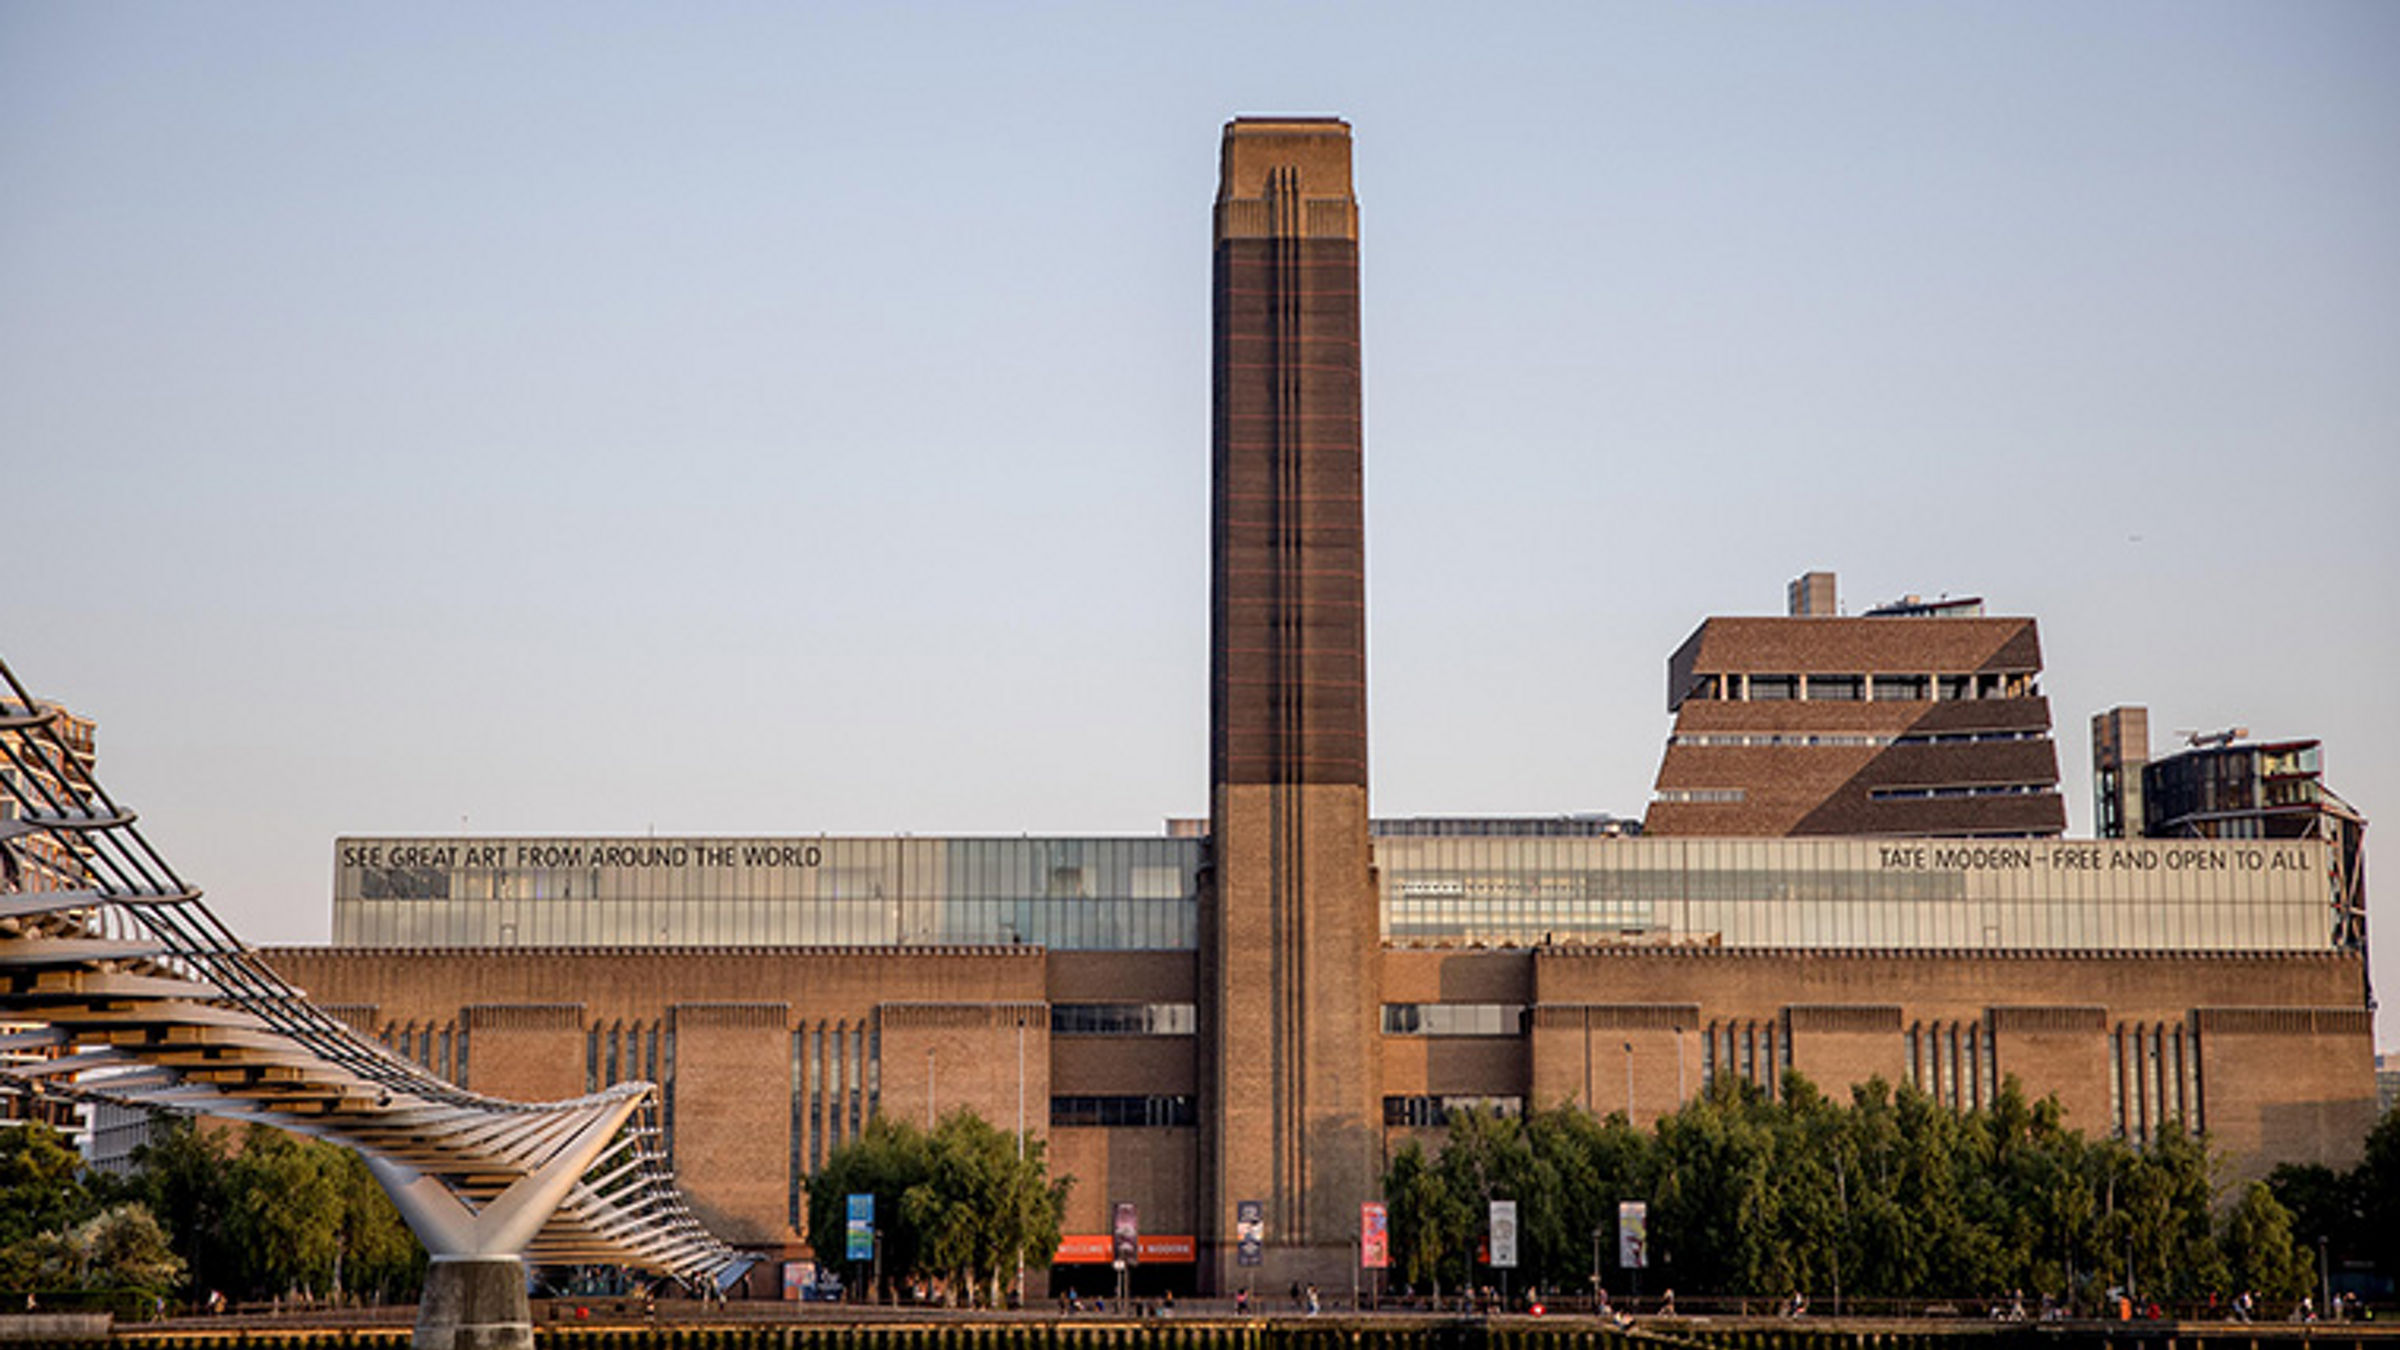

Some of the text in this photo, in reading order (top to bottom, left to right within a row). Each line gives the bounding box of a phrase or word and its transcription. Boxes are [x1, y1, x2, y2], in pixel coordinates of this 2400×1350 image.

[344, 846, 822, 867] SEE GREAT ART FROM AROUND THE WORLD
[1878, 848, 1926, 870] TATE
[1935, 848, 2032, 870] MODERN
[2053, 848, 2102, 870] FREE
[2109, 848, 2158, 870] AND
[2165, 848, 2226, 870] OPEN
[2235, 848, 2262, 870] TO
[2270, 848, 2311, 870] ALL
